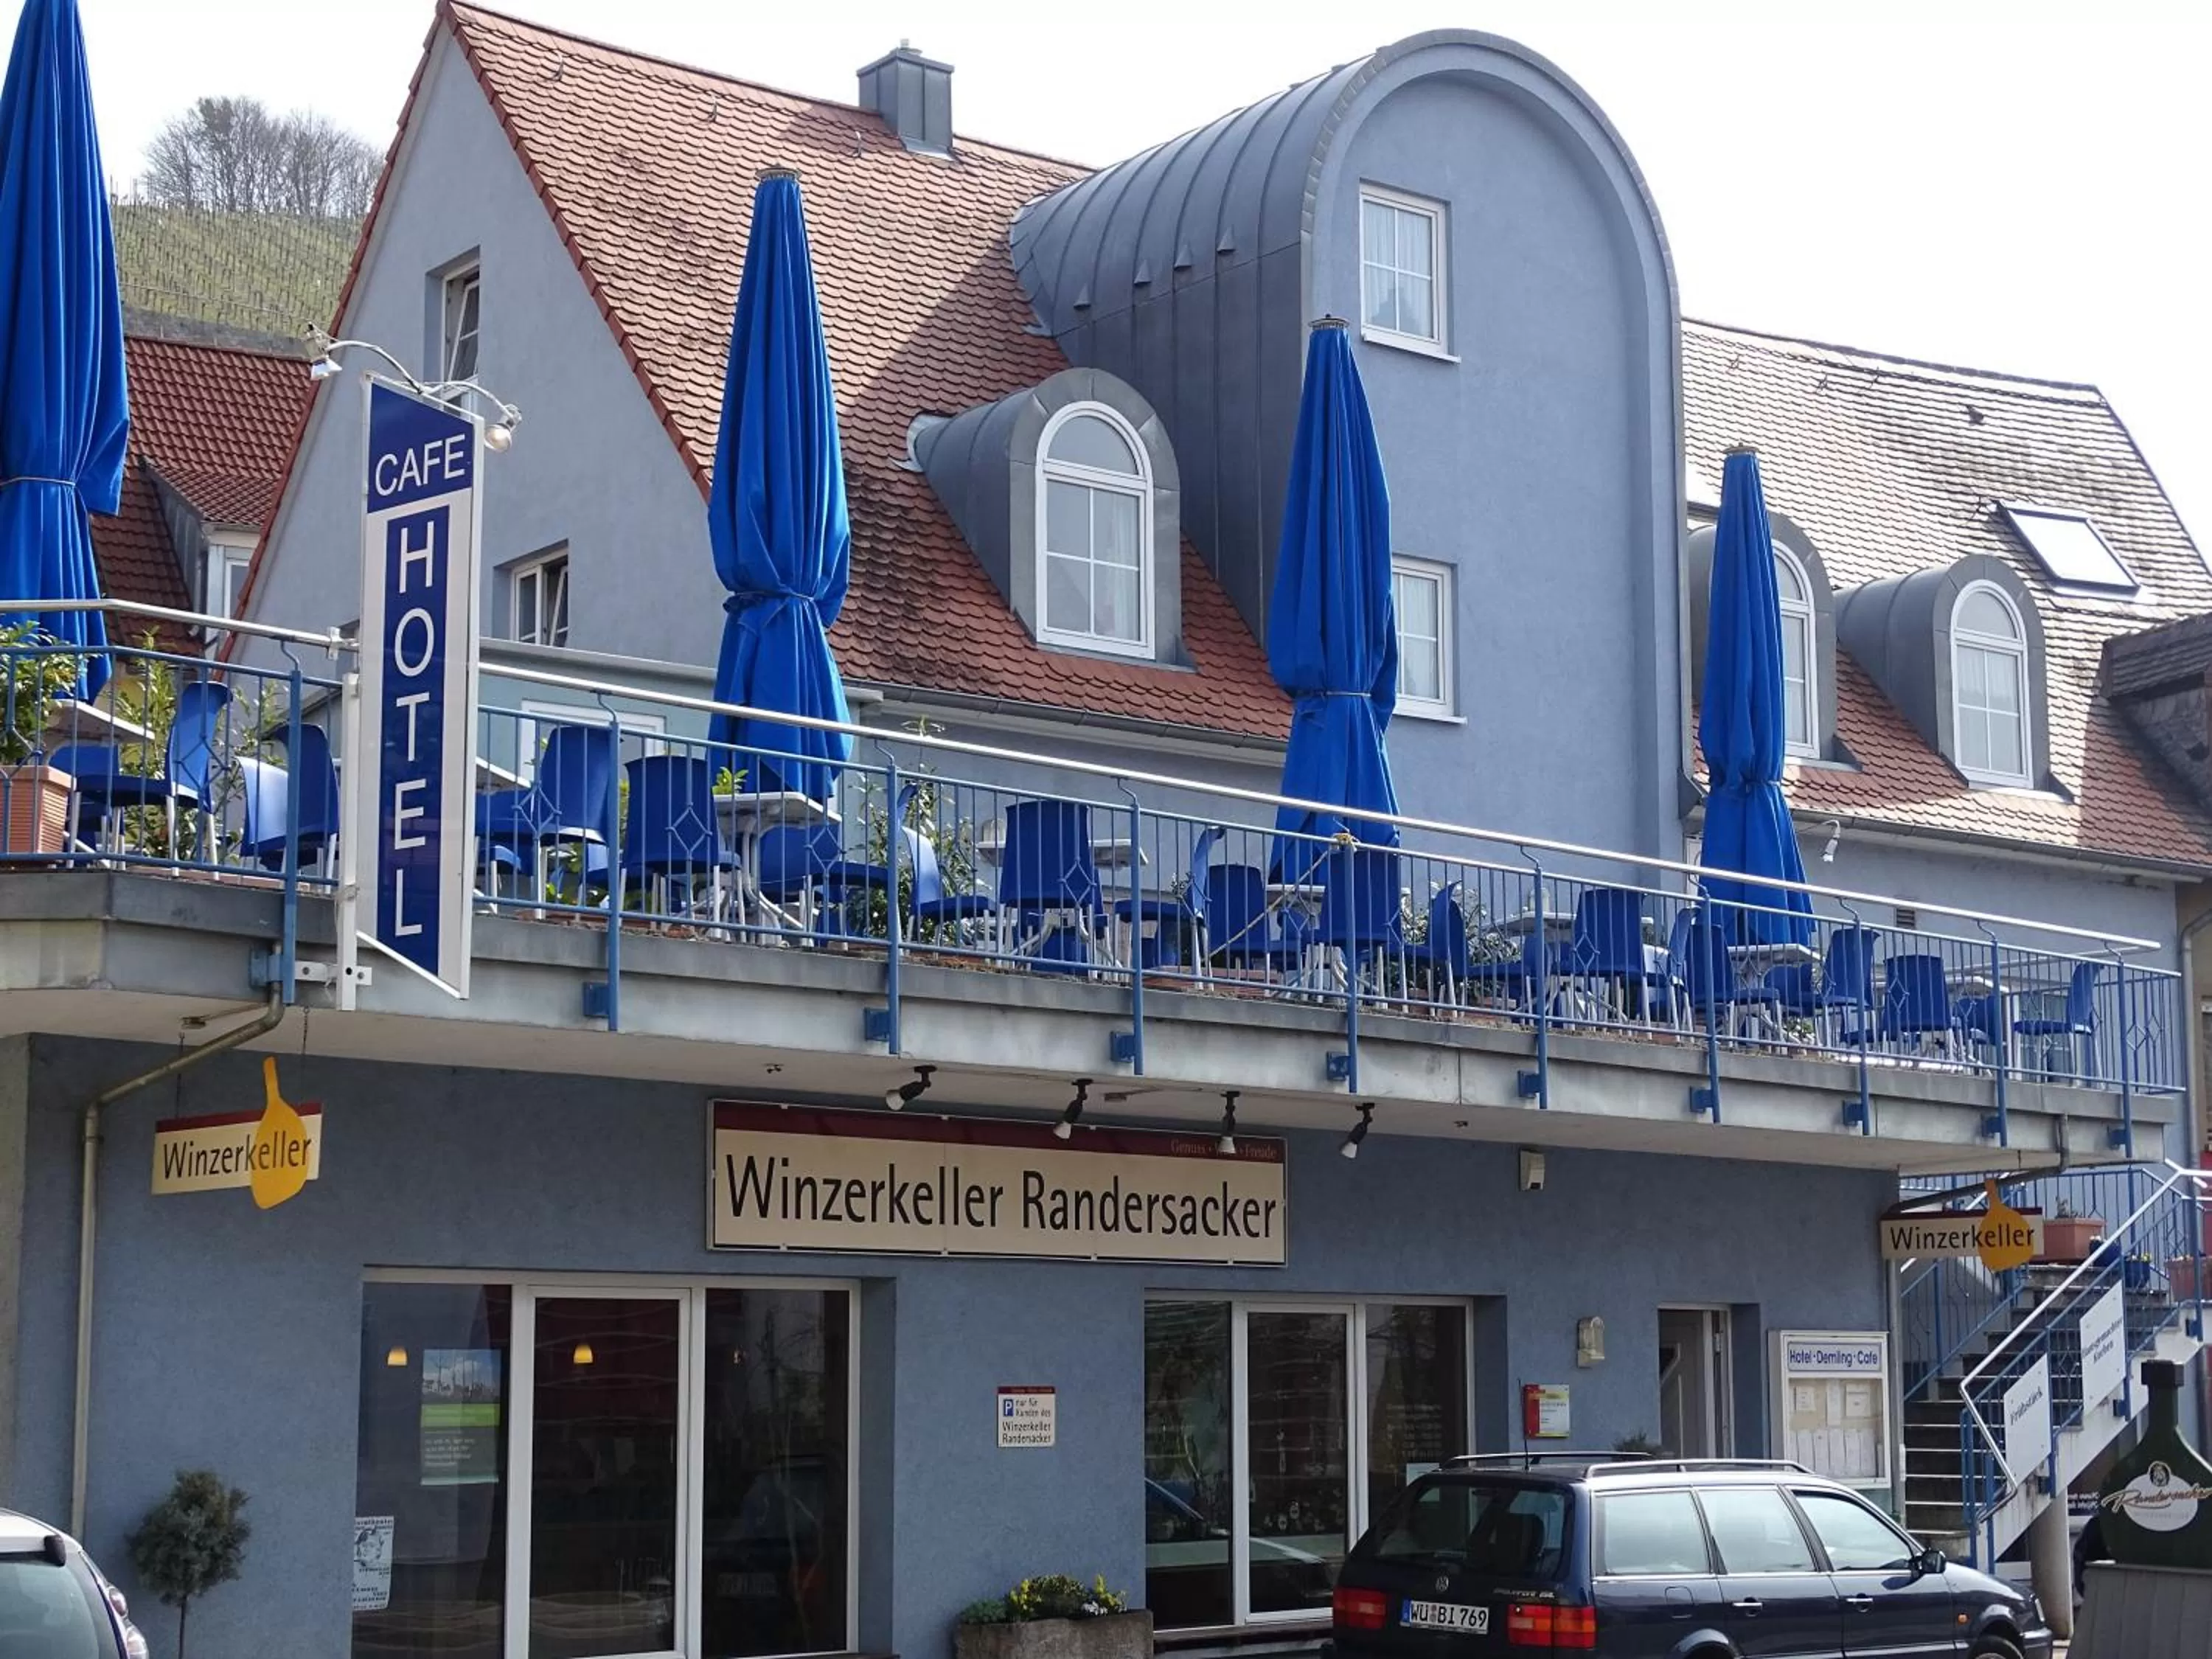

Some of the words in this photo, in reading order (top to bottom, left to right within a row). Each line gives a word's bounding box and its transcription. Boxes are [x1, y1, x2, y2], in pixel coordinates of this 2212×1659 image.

[375, 433, 466, 496] CAFE
[393, 521, 435, 936] HOTEL
[163, 1130, 312, 1180] Winzerkeller
[726, 1154, 1004, 1228] Winzerkeller
[1023, 1170, 1276, 1238] Randersacker
[1891, 1223, 2035, 1251] Winzerkeller
[1790, 1349, 1812, 1363] Hotel
[1816, 1350, 1853, 1368] Demling
[1857, 1351, 1878, 1365] Cafe
[1005, 1400, 1013, 1416] P
[1002, 1421, 1051, 1431] Winzerkeller
[1002, 1433, 1051, 1444] Randersacker
[1460, 1607, 1488, 1628] 769
